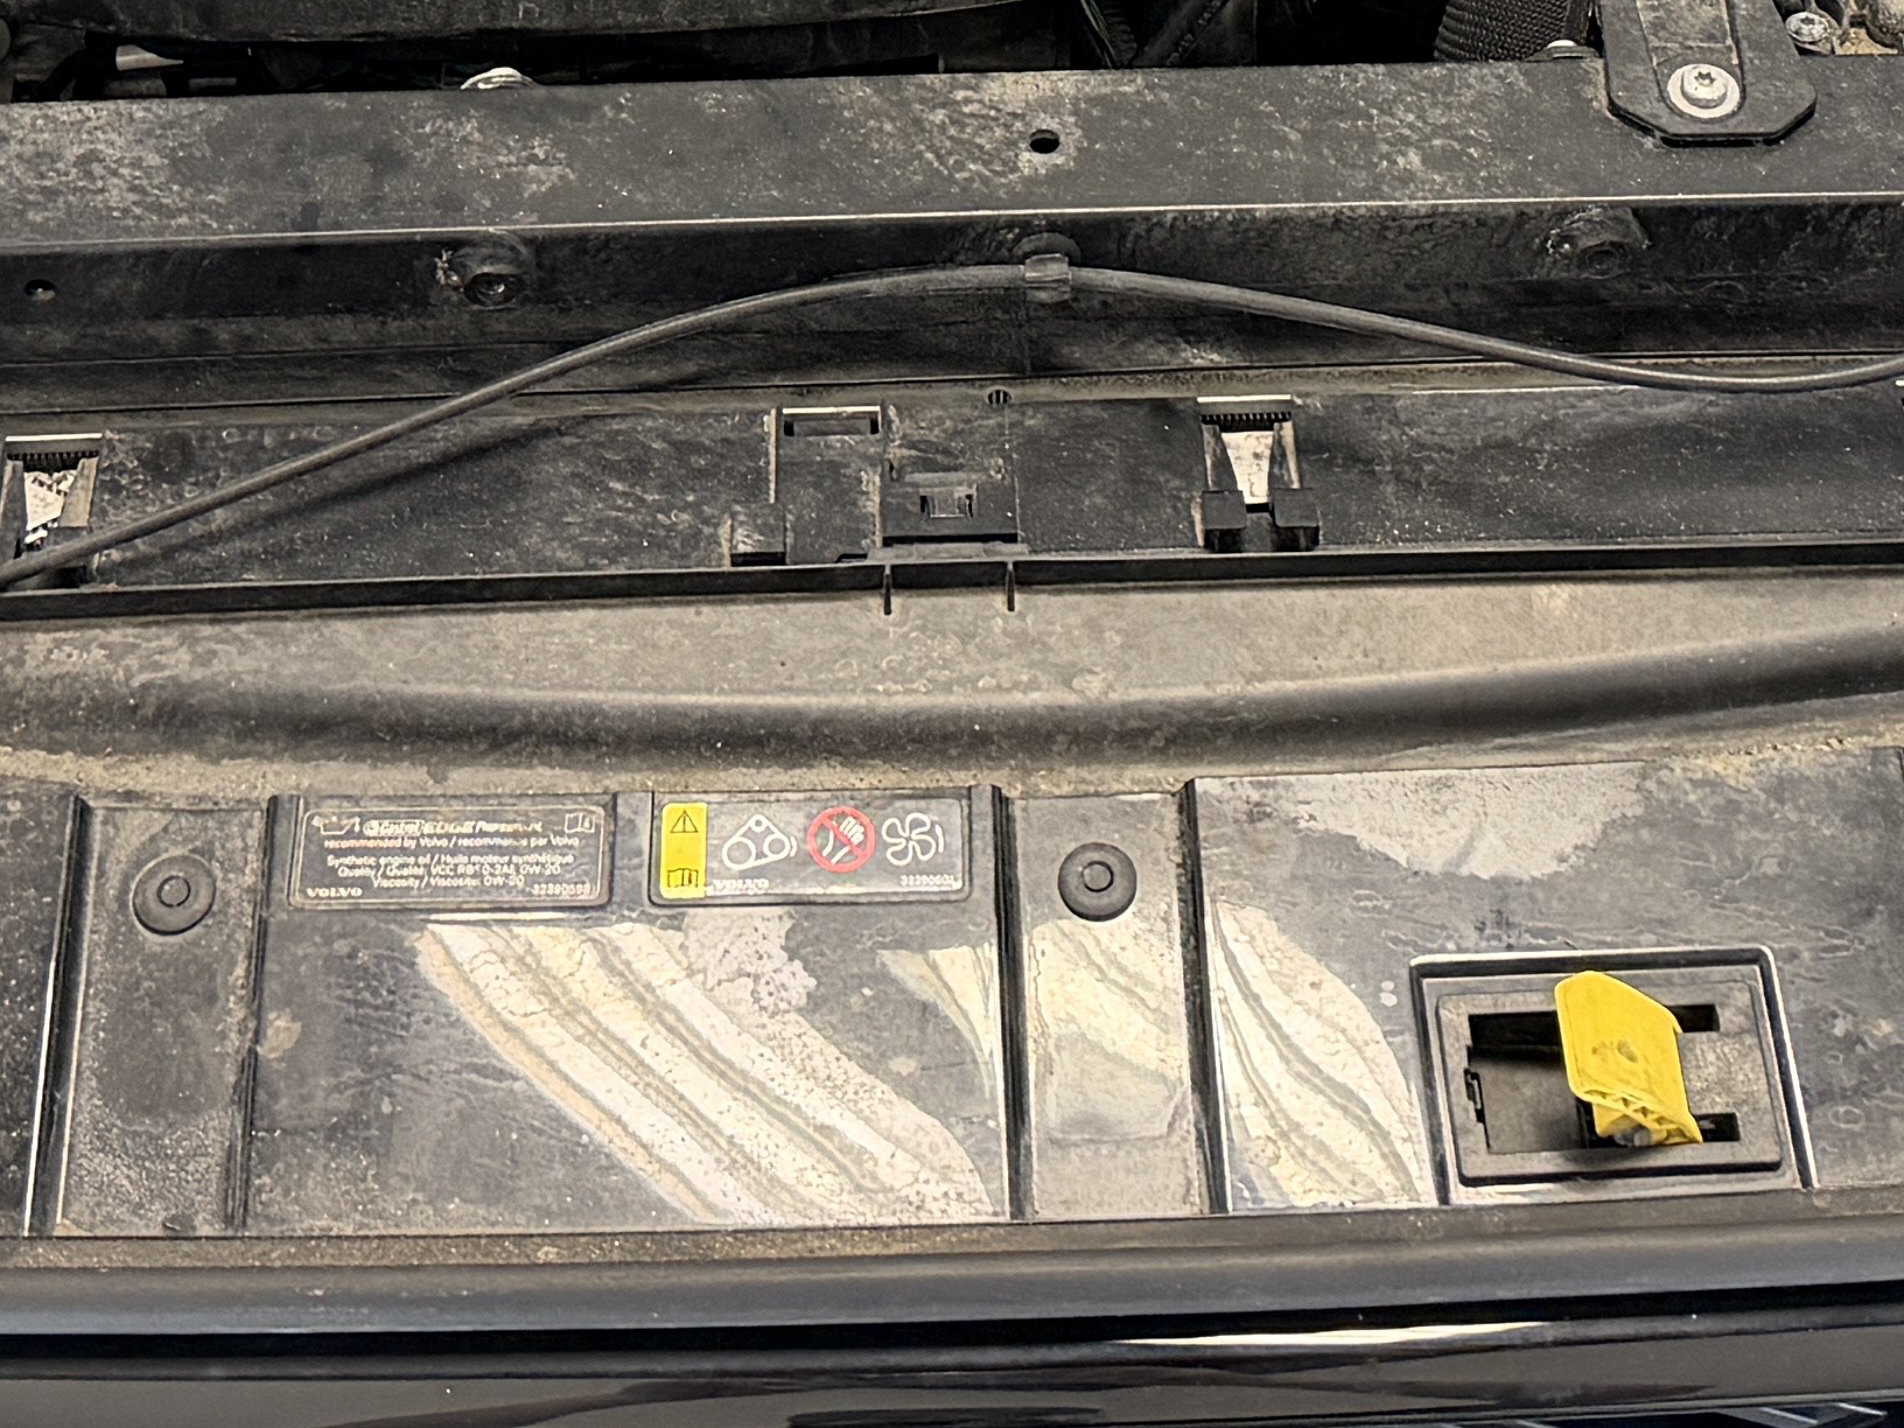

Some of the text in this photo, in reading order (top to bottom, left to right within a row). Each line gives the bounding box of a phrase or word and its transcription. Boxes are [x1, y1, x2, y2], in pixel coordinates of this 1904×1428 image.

[324, 838, 402, 849] recommended
[403, 838, 417, 850] by
[419, 836, 449, 847] Volvo
[327, 854, 377, 868] Synthetic
[337, 865, 375, 879] Quality
[431, 864, 455, 876] VCC
[371, 876, 420, 889] Viscosity
[306, 887, 363, 898] VOLVO
